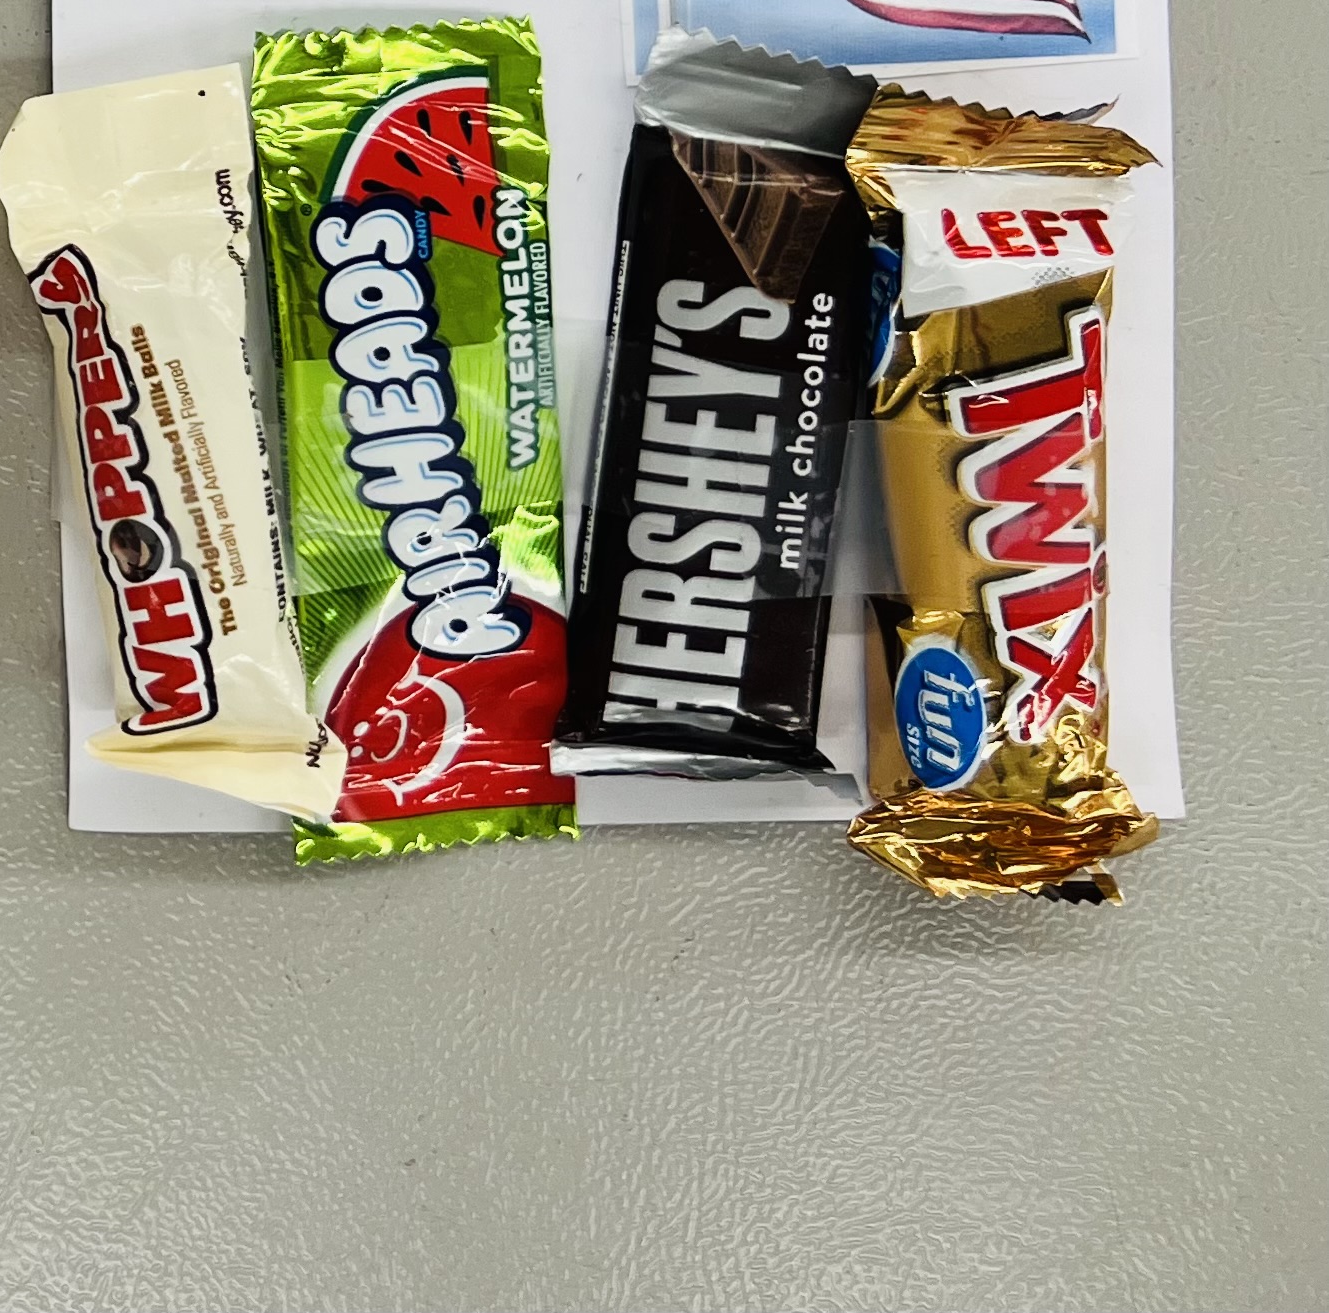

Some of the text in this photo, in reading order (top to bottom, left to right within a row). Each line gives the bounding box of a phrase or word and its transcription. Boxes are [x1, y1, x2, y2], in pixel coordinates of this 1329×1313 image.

[415, 210, 429, 259] CANDY
[496, 189, 536, 468] WATERMELON
[530, 242, 554, 407] ARTIFICIALLY FLAVORED
[941, 208, 1114, 258] LEFT
[130, 323, 238, 636] The Original Malted Milk Balls
[164, 358, 248, 587] Naturally and Artificially Flavored
[315, 208, 521, 655] AIRHEADS
[602, 279, 790, 733] HERSHEY'S
[775, 292, 834, 570] milk chocolate
[918, 670, 975, 772] fun
